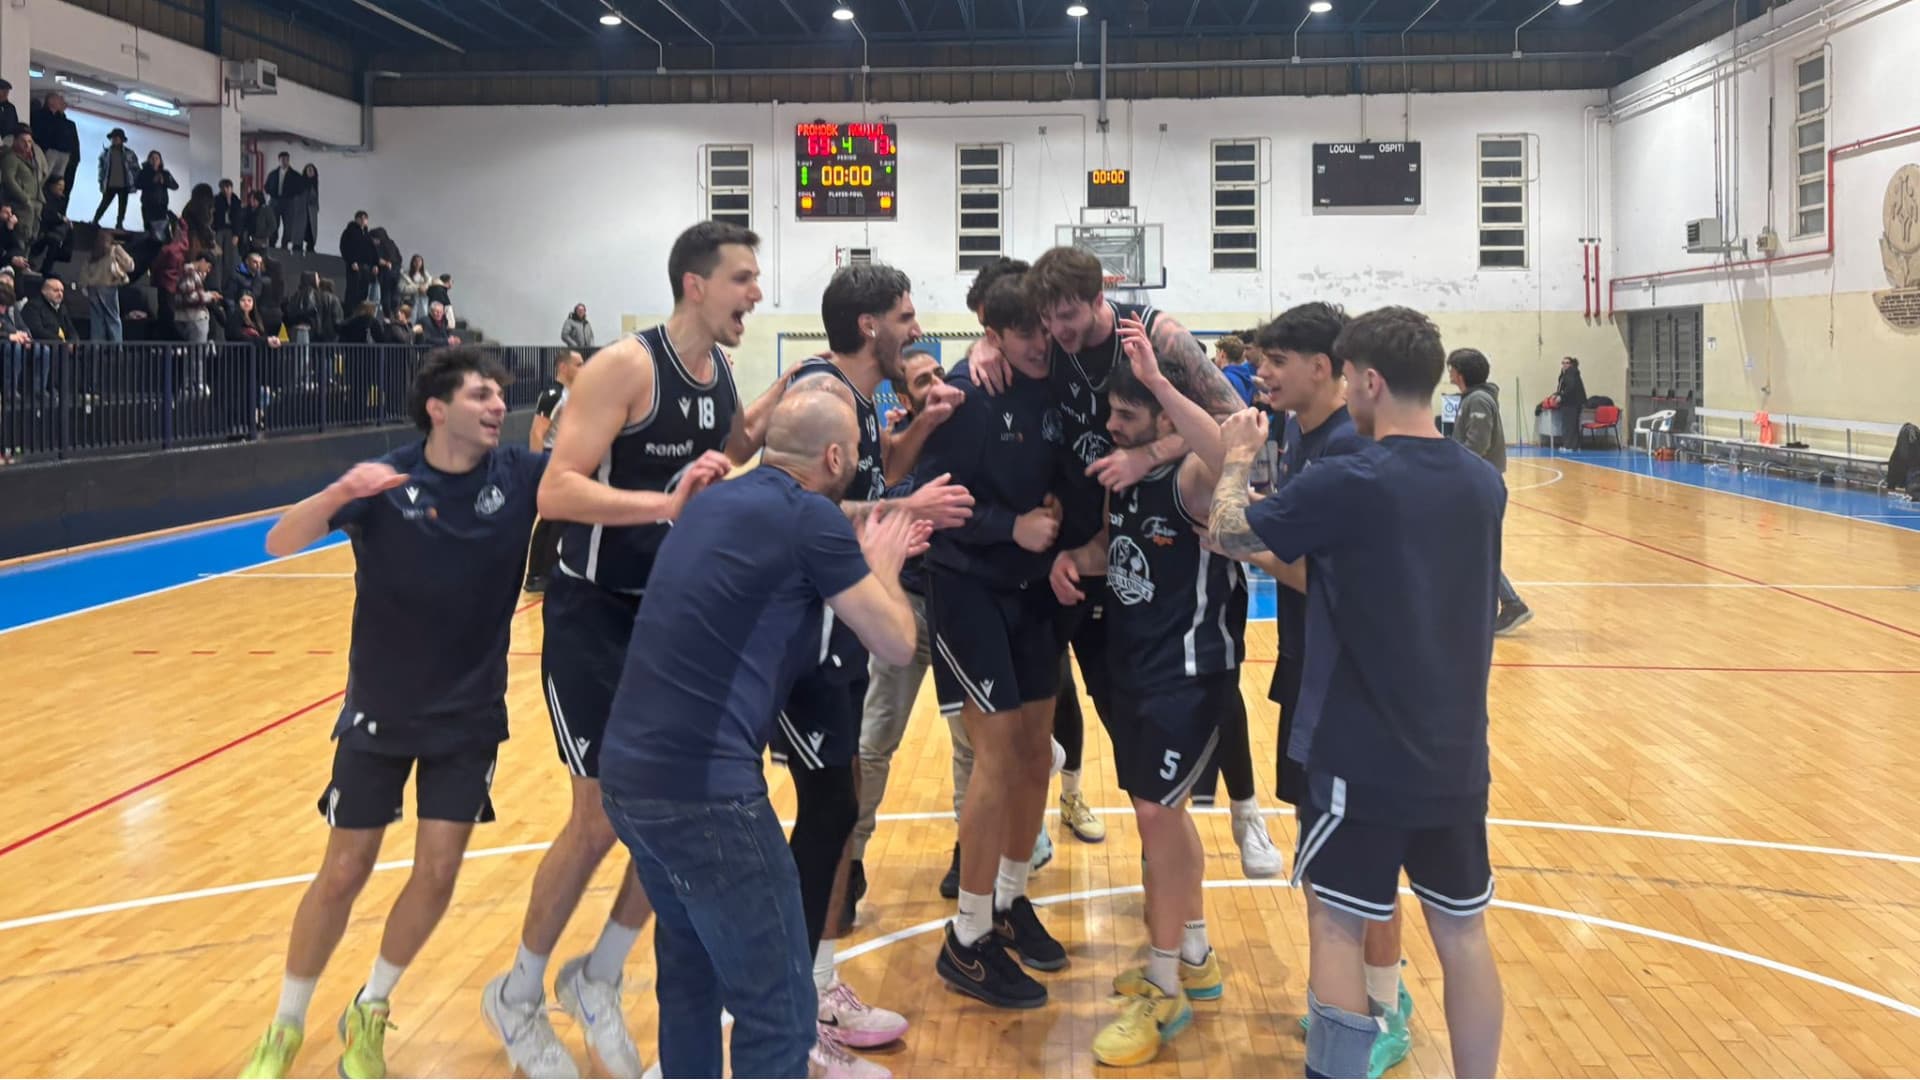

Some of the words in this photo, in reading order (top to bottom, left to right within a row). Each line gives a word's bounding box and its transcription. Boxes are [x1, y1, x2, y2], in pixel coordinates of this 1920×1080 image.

[842, 136, 853, 154] 4
[1329, 144, 1356, 154] LOCALI
[1378, 143, 1405, 153] OSPITI
[821, 165, 872, 186] 00:00
[1092, 170, 1125, 184] 00:00
[697, 396, 715, 430] 18
[1159, 749, 1181, 781] 5
